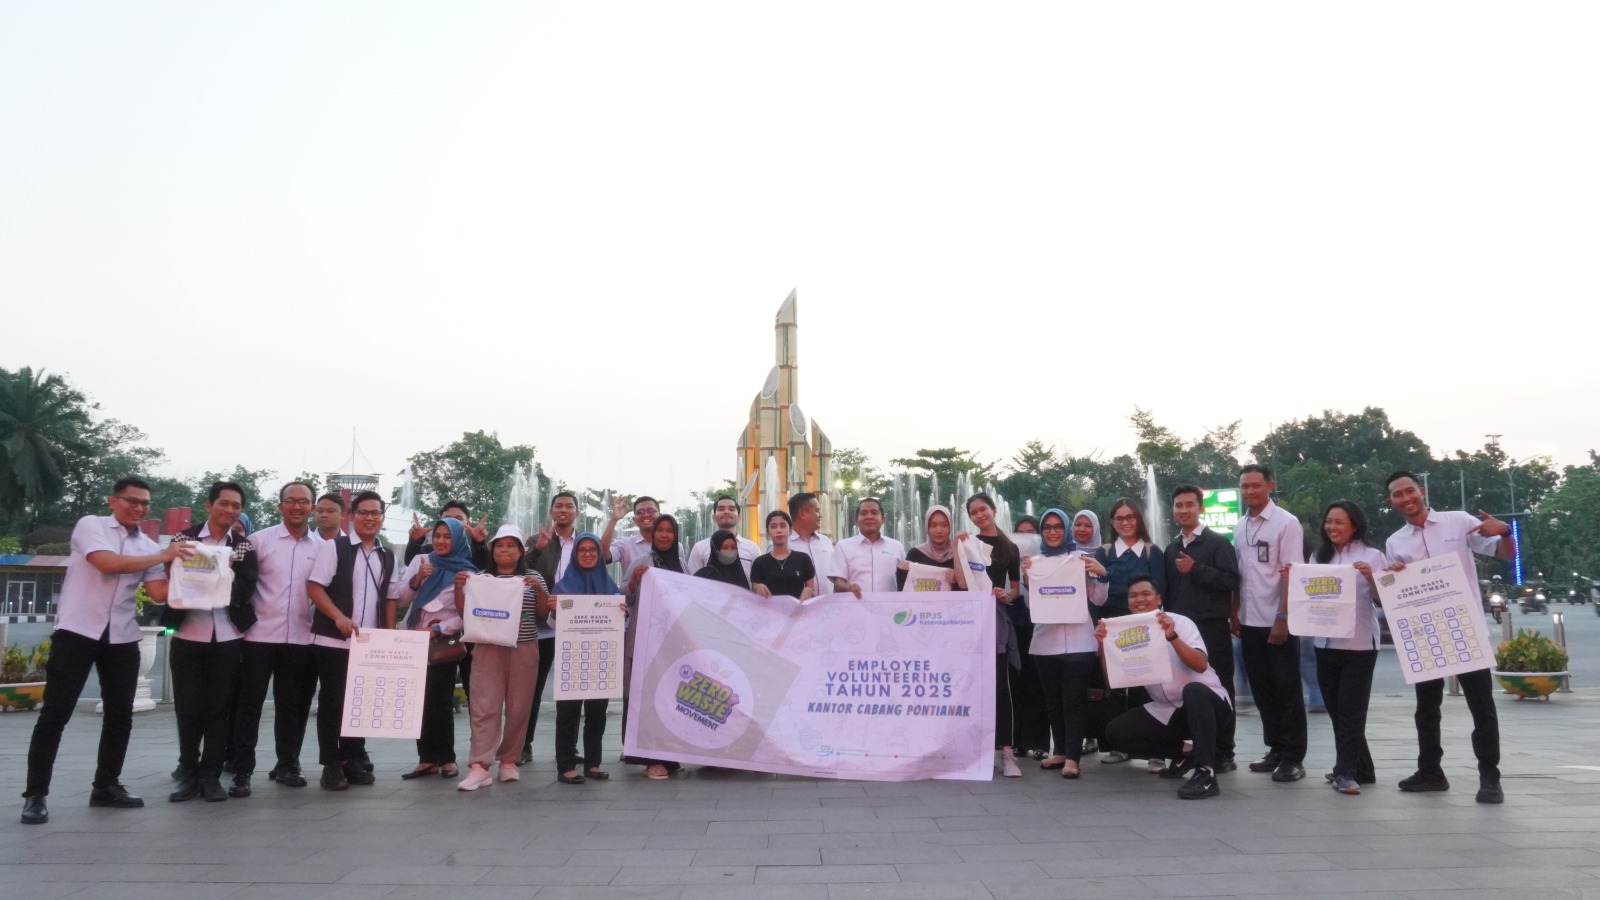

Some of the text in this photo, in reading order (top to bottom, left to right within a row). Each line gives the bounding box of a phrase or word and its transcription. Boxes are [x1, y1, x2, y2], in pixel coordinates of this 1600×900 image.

[1198, 512, 1239, 527] SAFARI
[1309, 577, 1336, 586] ZERO
[1401, 579, 1444, 593] ZERO WASTE
[1304, 585, 1339, 594] WASTE
[1397, 582, 1451, 600] COMMITMENT
[919, 612, 943, 620] BPJS
[1119, 626, 1143, 638] ZERO
[1115, 633, 1148, 647] WASTE
[848, 660, 931, 671] EMPLOYEE
[827, 672, 952, 684] VOLUNTEERING
[690, 673, 732, 702] ZERO
[825, 683, 953, 698] TAHUN 2025
[677, 683, 731, 719] WASTE
[807, 702, 972, 717] KANTOR CABANG PONTIANAK
[675, 703, 720, 731] MOVEMENT
